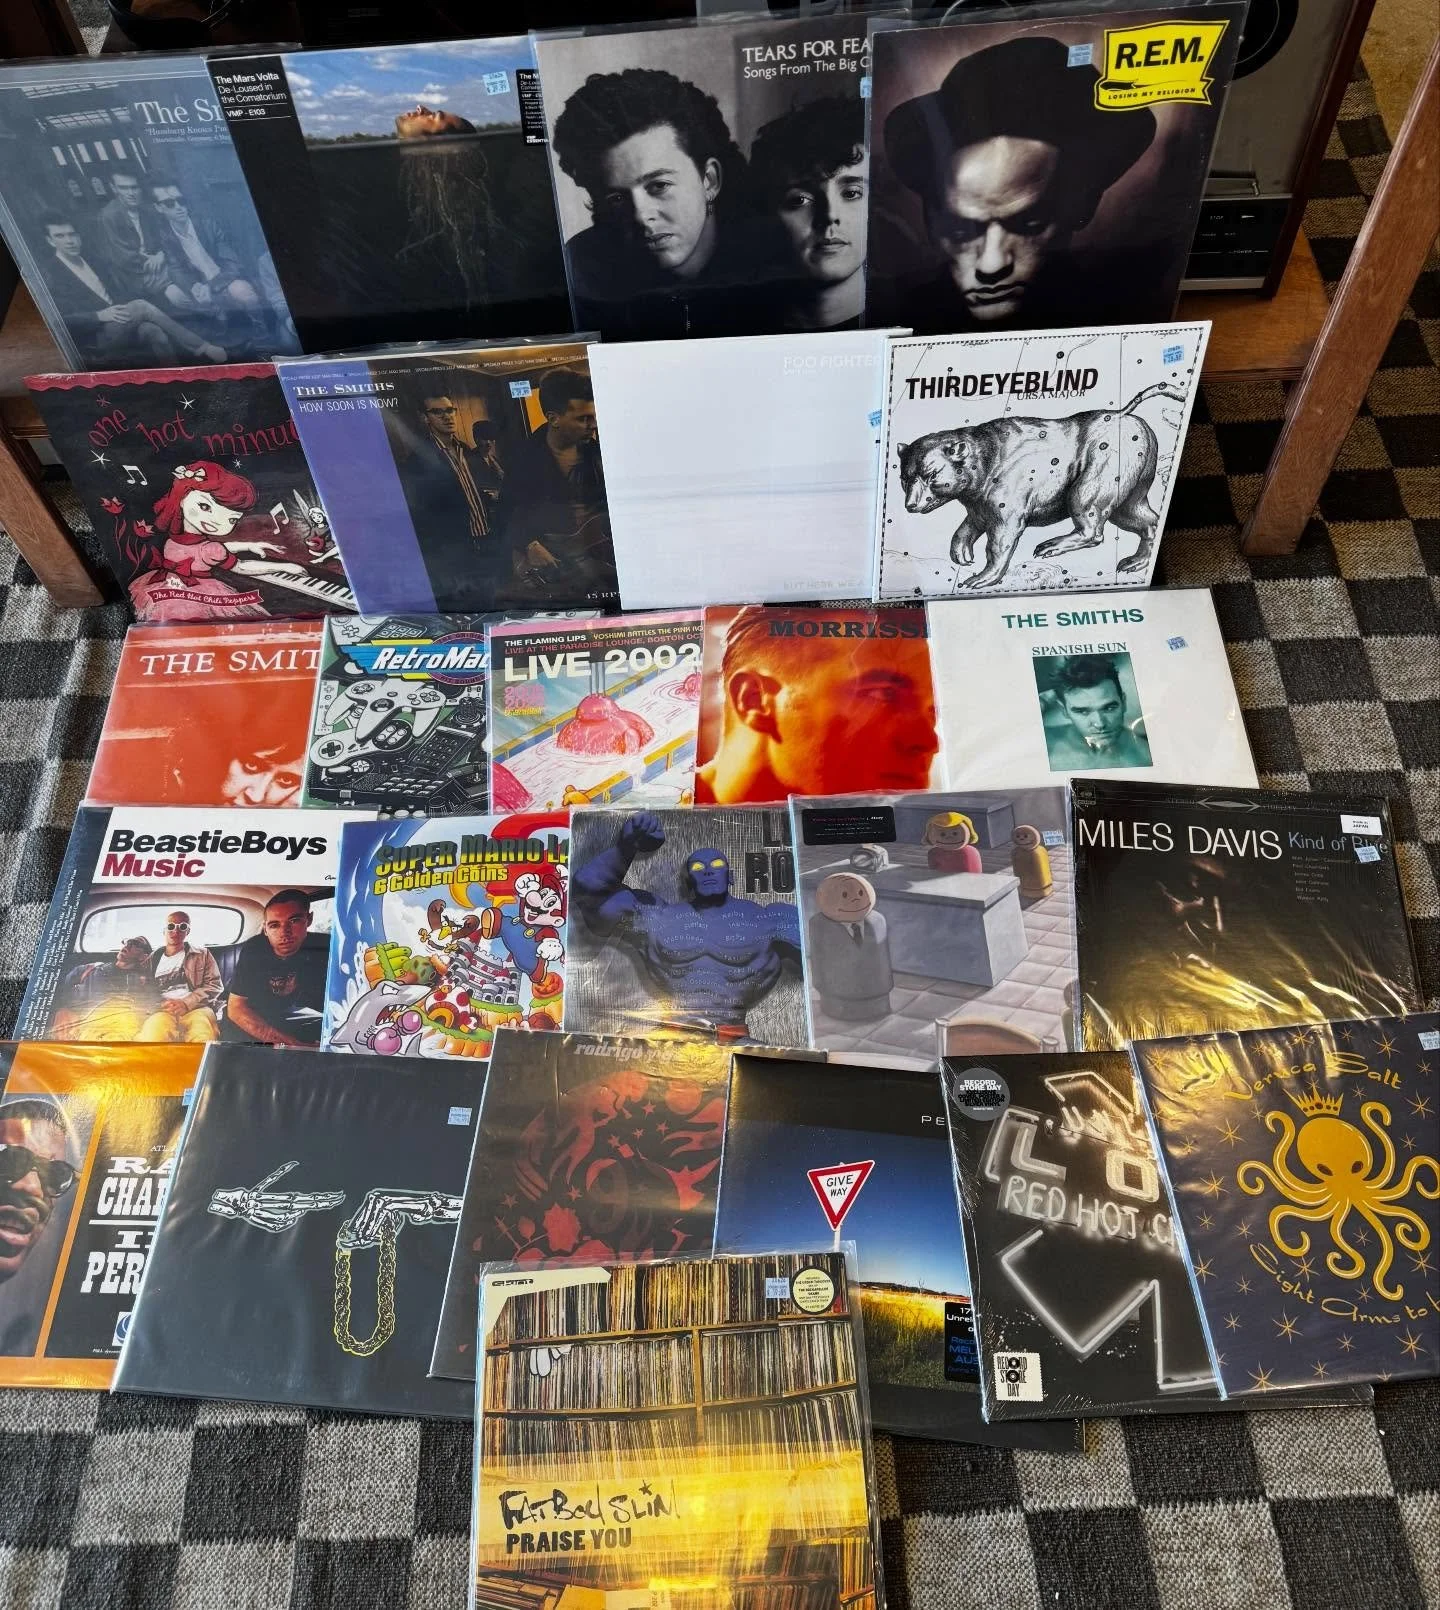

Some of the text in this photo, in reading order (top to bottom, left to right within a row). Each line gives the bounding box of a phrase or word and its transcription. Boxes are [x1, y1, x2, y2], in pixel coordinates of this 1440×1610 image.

[742, 44, 796, 63] TEARS
[803, 40, 837, 58] FOR
[1115, 36, 1204, 69] R.E.M.
[744, 66, 777, 80] Songs
[780, 64, 810, 75] From
[814, 60, 836, 72] The
[839, 58, 857, 72] Big
[214, 76, 232, 84] The
[232, 75, 256, 83] Mars
[218, 84, 264, 94] De-Loused
[1108, 92, 1138, 100] LOSING
[1157, 88, 1196, 96] RELIGION
[236, 93, 286, 103] Comatorium
[134, 101, 190, 125] The
[784, 356, 816, 369] FOO
[293, 382, 395, 396] THE SMITHS
[906, 368, 1098, 400] THIRDEYEBLIND
[1017, 388, 1086, 401] URSA MAJOR
[300, 397, 400, 412] HOW SOON IS NOW?
[88, 408, 130, 448] one
[136, 410, 195, 454] hot
[153, 591, 168, 600] The
[204, 595, 222, 604] Chili
[224, 595, 256, 604] Peppers
[1002, 609, 1144, 628] THE SMITHS
[505, 634, 586, 647] THE FLAMING LIPS
[594, 632, 626, 640] YOSHIMI
[628, 629, 656, 638] BATTLES
[560, 640, 603, 650] PARADISE
[606, 638, 645, 646] LOUNGE,
[1032, 642, 1127, 655] SPANISH SUN
[140, 652, 214, 676] THE
[505, 643, 701, 682] LIVE 2002
[109, 830, 327, 860] BeastieBoys
[1078, 818, 1174, 852] MILES
[1188, 825, 1282, 860] DAVIS
[1288, 832, 1324, 849] Kind
[1331, 837, 1347, 851] of
[374, 841, 457, 876] SUPER
[460, 834, 544, 865] MARIO
[102, 853, 206, 877] Music
[374, 865, 508, 896] 6 Golden Coins
[574, 1041, 644, 1062] rodrigo
[1223, 1051, 1402, 1100] Veruca Salt
[921, 1115, 946, 1126] PE
[826, 1174, 854, 1187] GIVE
[830, 1187, 849, 1197] WAY
[1005, 1175, 1066, 1221] RED
[1077, 1194, 1139, 1240] HOT
[1250, 1243, 1428, 1324] Eight Arms to
[997, 1356, 1027, 1370] RECORD
[1000, 1370, 1027, 1383] STORE
[1008, 1384, 1020, 1396] DAY
[506, 1527, 631, 1554] PRAISE YOU
